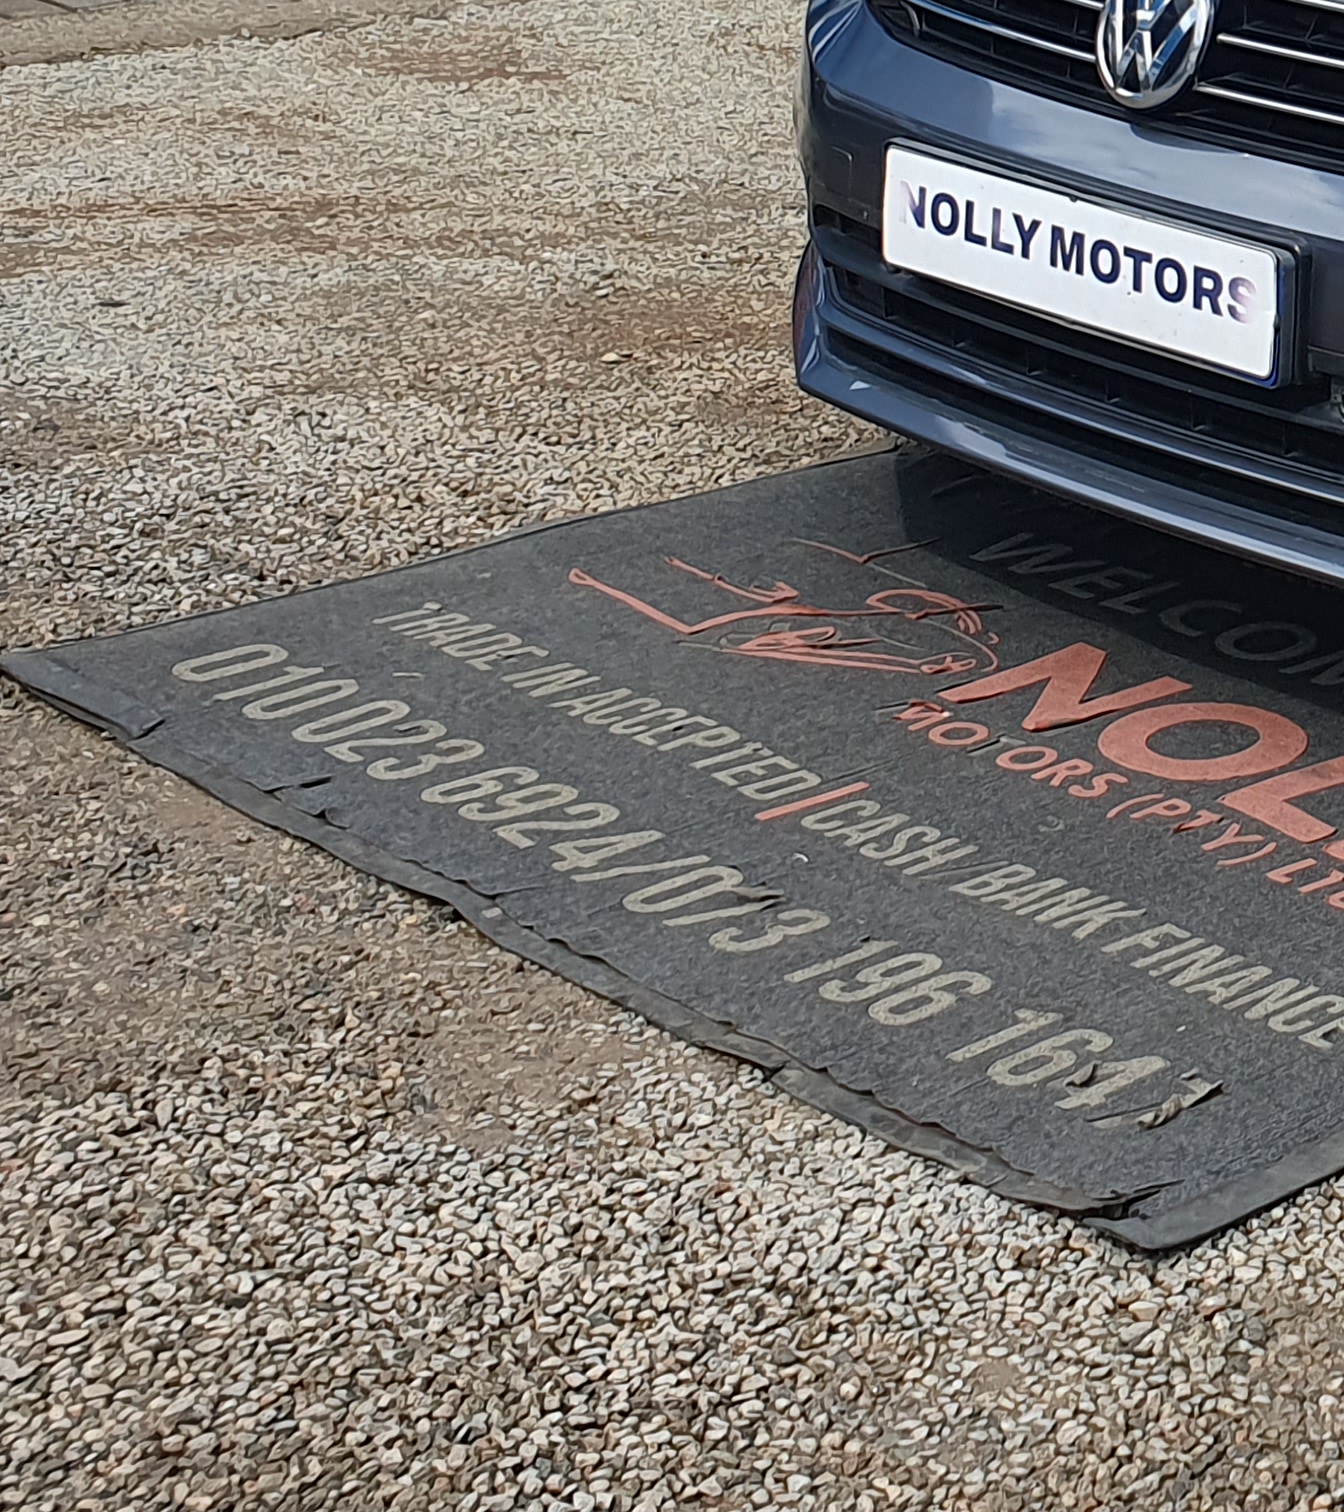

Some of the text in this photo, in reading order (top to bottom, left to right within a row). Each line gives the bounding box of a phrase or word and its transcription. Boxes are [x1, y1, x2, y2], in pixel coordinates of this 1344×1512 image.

[901, 180, 1258, 324] NOLLY MOTORS
[372, 601, 550, 672] TRADE
[502, 662, 600, 697] IN
[785, 938, 993, 1027] 196
